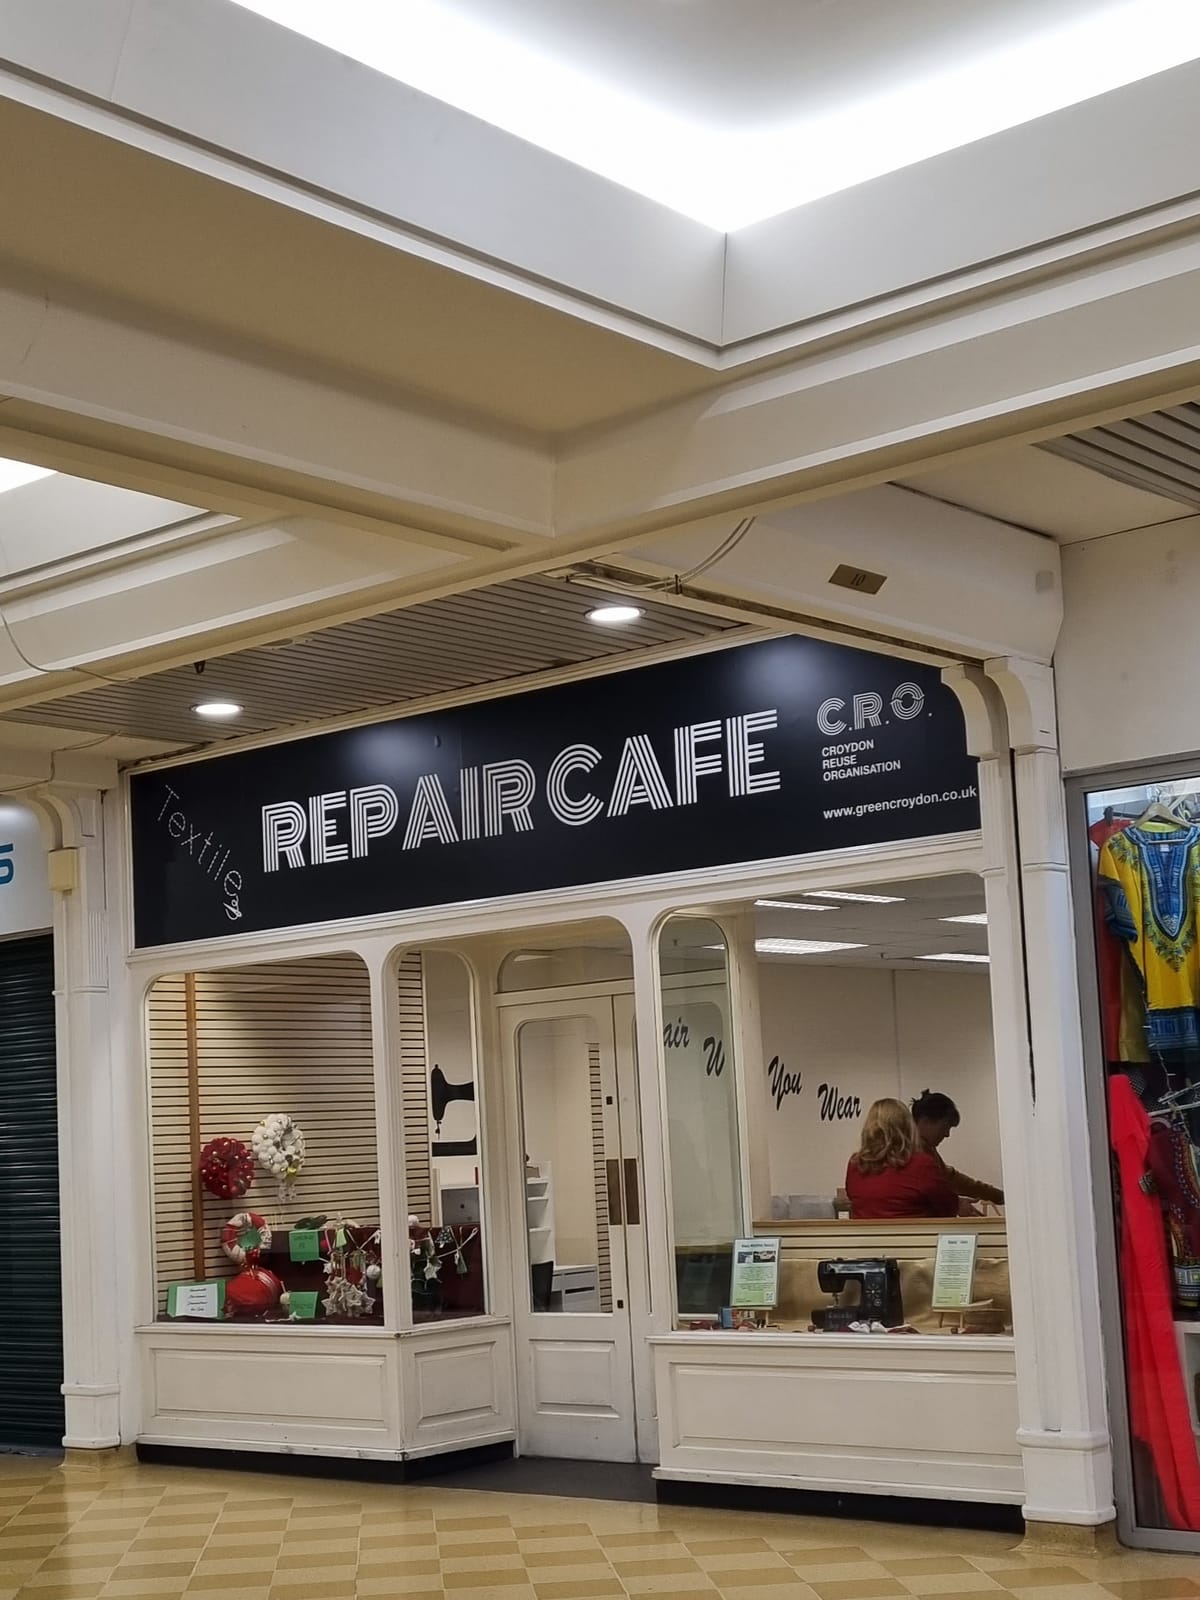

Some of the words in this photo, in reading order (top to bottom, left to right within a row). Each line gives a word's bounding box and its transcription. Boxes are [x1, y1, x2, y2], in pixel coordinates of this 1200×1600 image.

[850, 572, 867, 587] 10
[821, 739, 875, 758] CROYDON
[822, 754, 858, 770] REUSE
[822, 760, 902, 782] ORGANISATION
[261, 758, 537, 874] REPAIR
[546, 708, 782, 828] CAFE
[823, 785, 978, 820] www.greencroydon.co.uk
[157, 784, 243, 897] Textile
[768, 1055, 803, 1111] You
[817, 1082, 862, 1121] Wear
